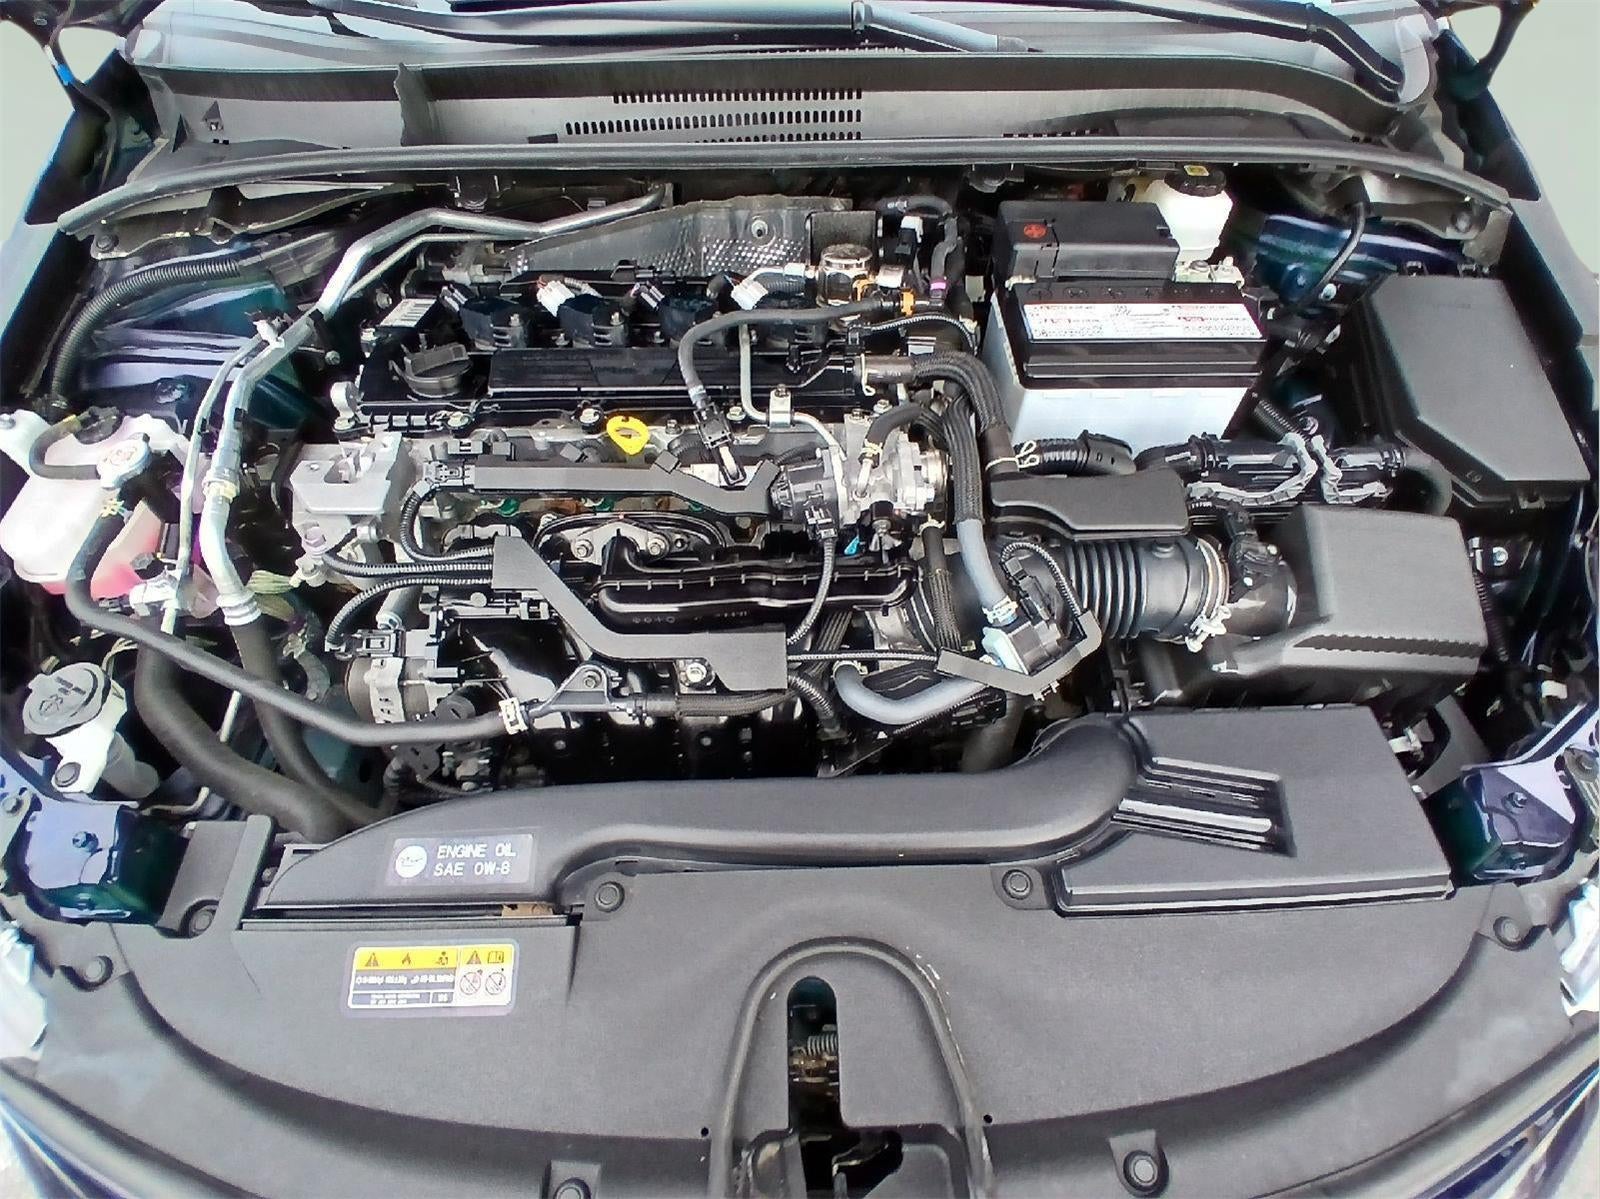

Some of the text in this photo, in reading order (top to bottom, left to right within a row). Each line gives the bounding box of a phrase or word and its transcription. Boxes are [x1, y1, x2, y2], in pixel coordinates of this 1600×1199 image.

[437, 842, 517, 858] ENGINE OIL
[433, 862, 464, 876] SAE
